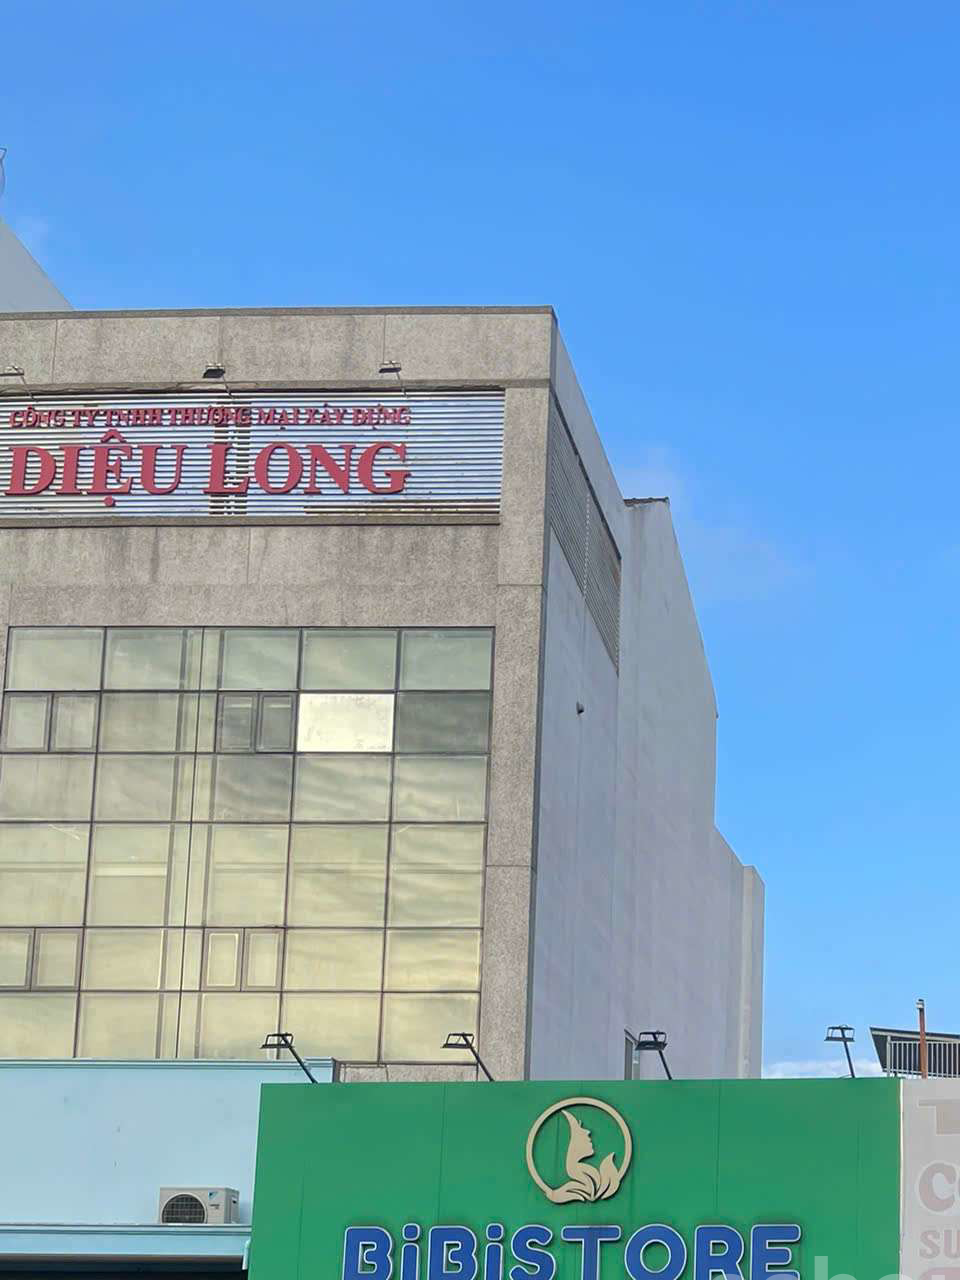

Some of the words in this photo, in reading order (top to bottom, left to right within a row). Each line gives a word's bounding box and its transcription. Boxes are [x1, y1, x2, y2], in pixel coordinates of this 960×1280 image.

[9, 405, 65, 427] CÔNG
[72, 409, 98, 427] TY
[105, 408, 163, 426] TNHH
[258, 407, 300, 430] MẠI
[304, 403, 347, 425] XÂY
[3, 429, 189, 507] DIỆU
[203, 441, 412, 494] LONG
